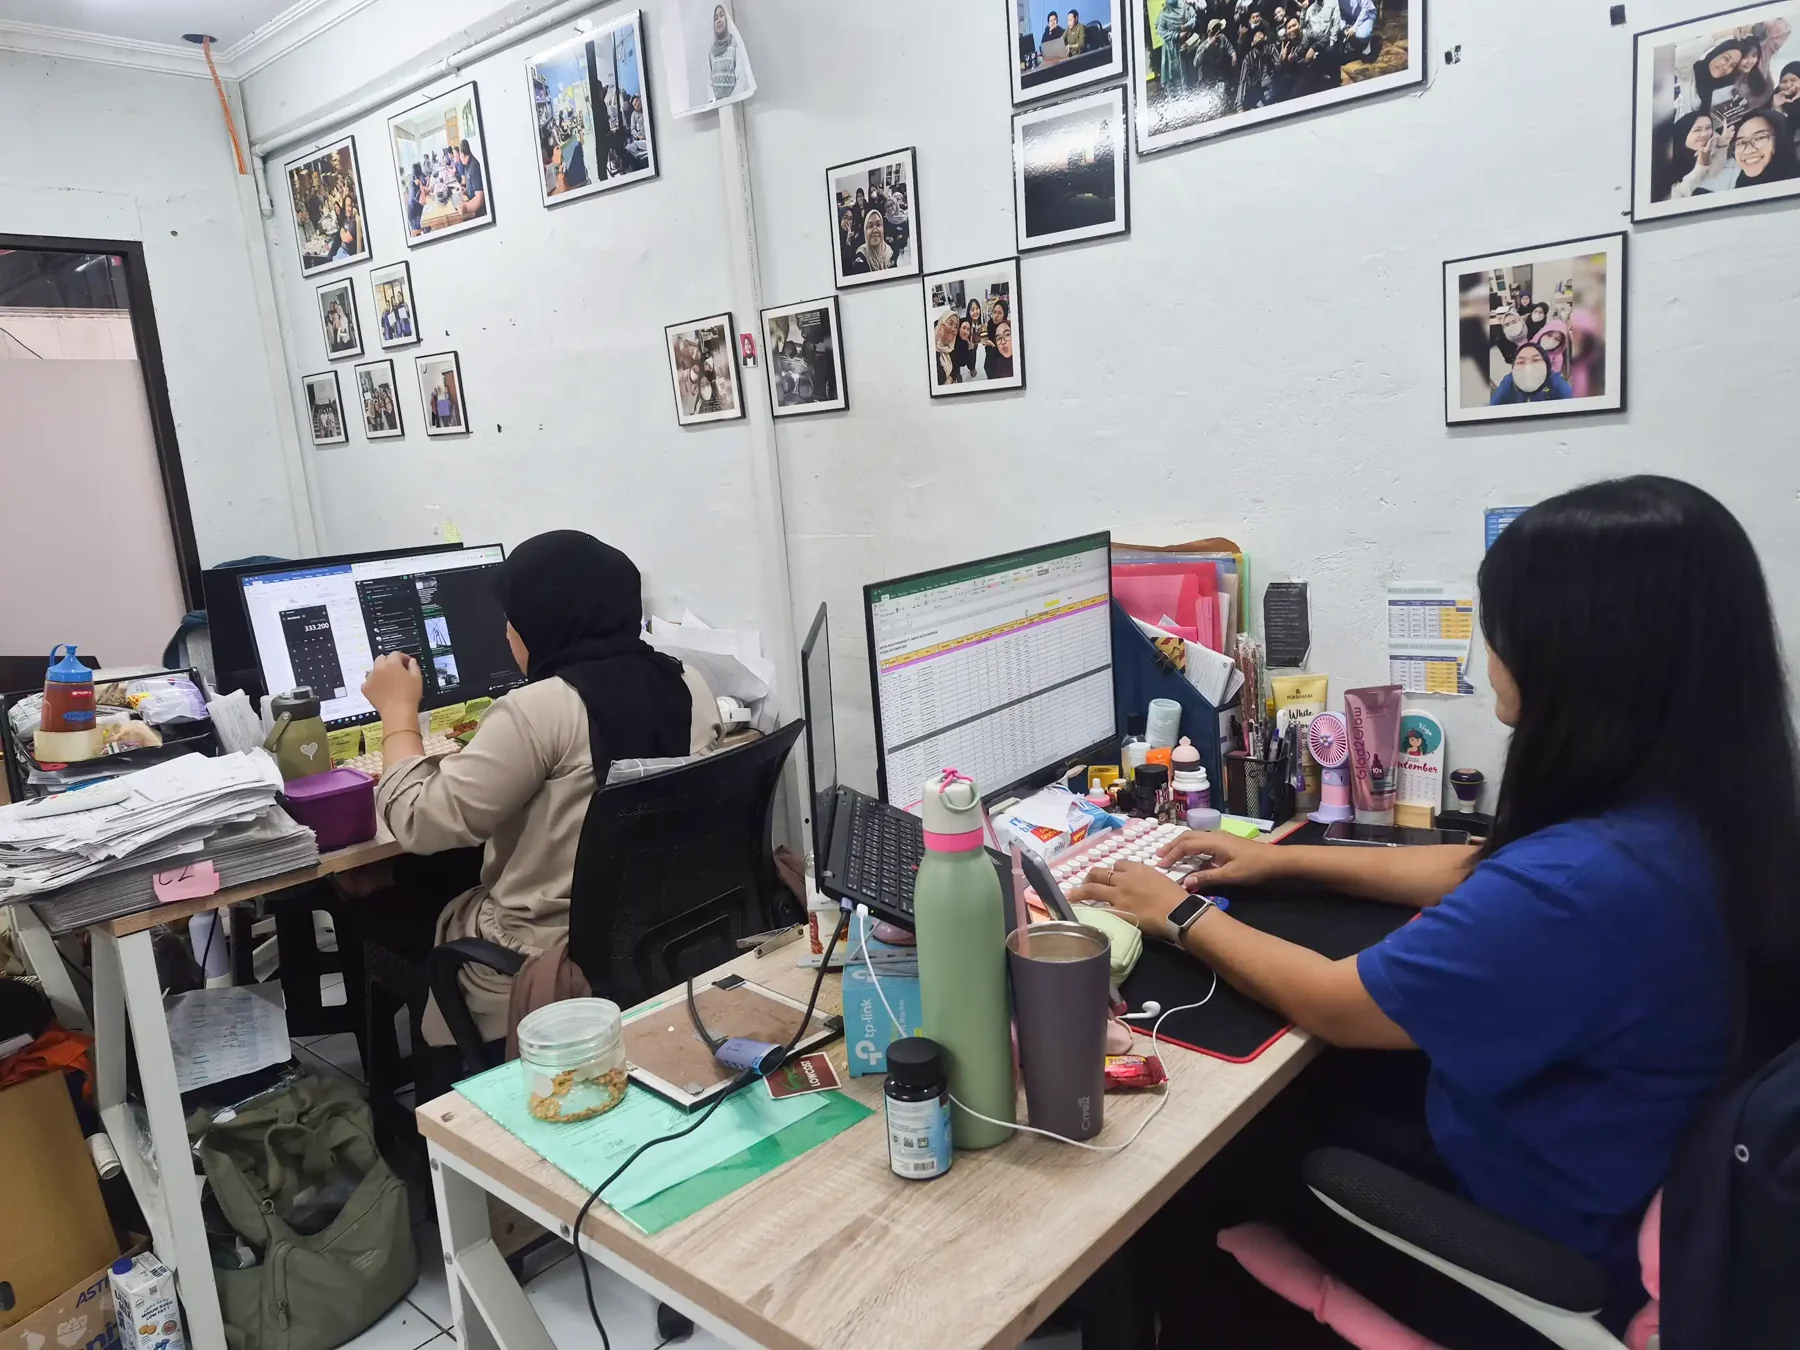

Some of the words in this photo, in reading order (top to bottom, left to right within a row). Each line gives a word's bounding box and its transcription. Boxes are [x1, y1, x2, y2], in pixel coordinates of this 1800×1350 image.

[304, 622, 330, 632] 333.200
[1288, 709, 1314, 720] White
[1353, 707, 1371, 780] Glad2Glow
[860, 998, 877, 1038] tp-link
[800, 1060, 821, 1087] LOWCOST
